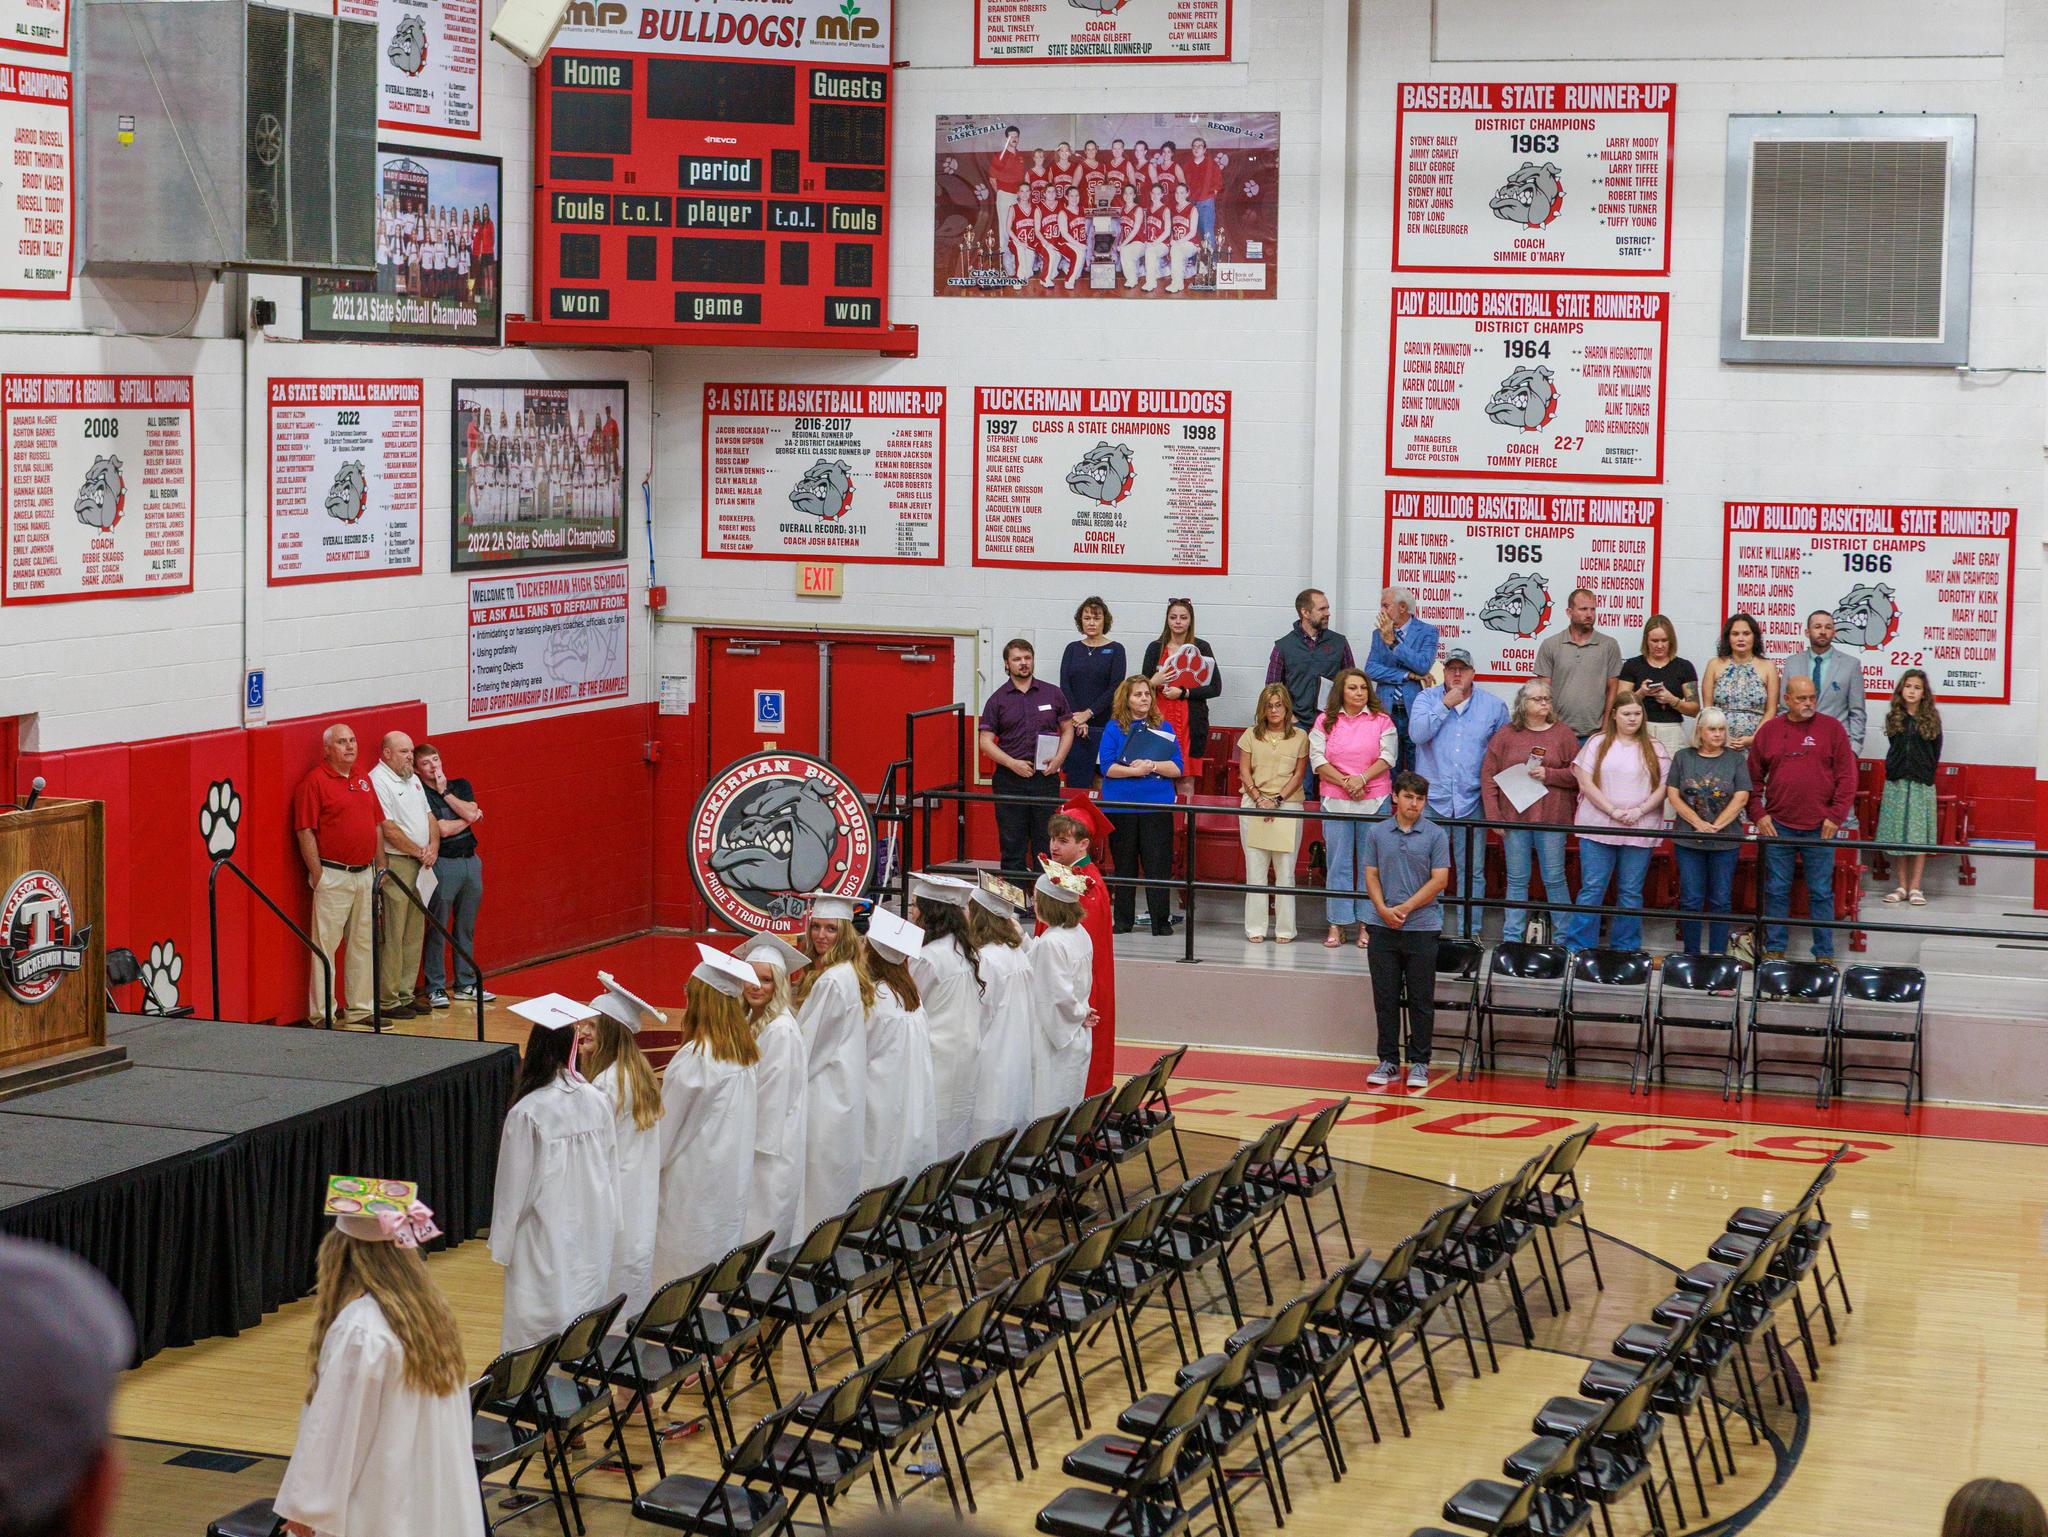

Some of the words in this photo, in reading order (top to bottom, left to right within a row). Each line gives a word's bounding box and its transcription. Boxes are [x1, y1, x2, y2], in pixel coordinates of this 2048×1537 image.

[637, 8, 807, 48] BULLDOGS!
[988, 25, 1005, 33] PAUL
[1007, 25, 1035, 33] TINSLEY
[1085, 21, 1117, 31] COACH
[1048, 44, 1068, 56] STATE
[1070, 43, 1111, 55] BASKETBALL
[1113, 42, 1153, 55] RUNNER-UP
[564, 60, 620, 87] Home
[18, 70, 68, 99] CHAMPIONS
[815, 72, 882, 99] Guests
[1403, 85, 1493, 109] BASEBALL
[1501, 85, 1555, 110] STATE
[1565, 85, 1670, 110] RUNNER-UP
[947, 122, 1007, 143] BASKETBALL
[1207, 121, 1242, 135] RECORD
[1475, 119, 1526, 131] DISTRICT
[1529, 119, 1595, 131] CHAMPIONS
[1410, 136, 1435, 146] SYDNEY
[1436, 136, 1458, 146] BAILEY
[1510, 134, 1559, 153] 1963
[1601, 150, 1633, 160] MILLARD
[1635, 150, 1659, 160] SMITH
[690, 159, 750, 185] period
[558, 196, 605, 220] fouls
[688, 200, 752, 227] player
[776, 208, 816, 228] t.o.l.
[833, 206, 877, 231] fouls
[1514, 239, 1545, 249] COACH
[1493, 251, 1527, 262] SIMMIE
[1530, 251, 1566, 262] O'MARY
[948, 277, 976, 286] STATE
[977, 277, 1028, 287] CHAMPIONS
[562, 294, 600, 313] won
[694, 297, 743, 320] game
[836, 303, 871, 321] won
[1397, 291, 1424, 315] LADY
[1428, 292, 1478, 316] BULLDOG
[1482, 292, 1552, 317] BASKETBALL
[1556, 294, 1590, 318] STATE
[1593, 294, 1660, 320] RUNNER-UP
[332, 296, 356, 320] 2021
[357, 298, 369, 321] 2A
[370, 298, 395, 322] State
[396, 300, 431, 324] Softball
[431, 302, 477, 330] Champions
[1475, 321, 1529, 333] DISTRICT
[1534, 321, 1584, 335] CHAMPS
[1503, 340, 1551, 359] 1964
[1584, 346, 1608, 360] SHARON
[1609, 346, 1653, 361] HIGGINBOTTOM
[43, 379, 74, 403] DISTRICT
[76, 380, 81, 403] &
[83, 379, 116, 404] REGIONAL
[120, 380, 151, 404] SOFTBALL
[154, 380, 190, 404] CHAMPIONS
[273, 384, 286, 401] 2A
[288, 384, 318, 402] STATE
[320, 384, 366, 402] SOFTBALL
[368, 385, 419, 402] CHAMPIONS
[1402, 379, 1425, 392] KAREN
[1427, 379, 1455, 393] COLLOM
[707, 388, 731, 411] 3-A
[733, 389, 774, 412] STATE
[779, 389, 864, 414] BASKETBALL
[869, 391, 943, 414] RUNNER-UP
[981, 388, 1082, 412] TUCKERMAN
[1090, 390, 1132, 412] LADY
[1137, 391, 1226, 414] BULLDOGS
[337, 411, 360, 425] 2022
[795, 418, 851, 431] 2016-2017
[986, 420, 1018, 434] 1997
[84, 418, 119, 438] 2008
[1032, 421, 1065, 434] CLASS
[1068, 422, 1075, 434] A
[1079, 422, 1108, 435] STATE
[1112, 422, 1171, 436] CHAMPIONS
[1183, 425, 1217, 440] 1998
[1506, 444, 1539, 455] COACH
[1554, 436, 1584, 452] 22-7
[1487, 456, 1522, 468] TOMMY
[1525, 457, 1557, 469] PIERCE
[1392, 493, 1420, 517] LADY
[1423, 494, 1473, 518] BULLDOG
[1477, 495, 1546, 521] BASKETBALL
[1551, 498, 1585, 521] STATE
[1588, 499, 1655, 524] RUNNER-UP
[780, 524, 816, 534] OVERALL
[817, 524, 847, 535] RECORD:
[848, 525, 867, 535] 31-11
[1730, 505, 1760, 530] LADY
[1764, 506, 1816, 531] BULLDOG
[1820, 507, 1894, 533] BASKETBALL
[1900, 509, 1936, 534] STATE
[1940, 510, 2010, 536] RUNNER-UP
[468, 531, 490, 552] 2022
[492, 532, 505, 551] 2A
[506, 531, 530, 550] State
[532, 528, 566, 548] Softball
[567, 526, 616, 549] Champions
[1085, 532, 1116, 542] COACH
[1466, 525, 1520, 538] DISTRICT
[1524, 526, 1575, 539] CHAMPS
[91, 538, 115, 549] COACH
[1073, 543, 1099, 554] ALVIN
[1100, 543, 1126, 555] RILEY
[1811, 538, 1868, 551] DISTRICT
[1873, 539, 1925, 552] CHAMPS
[1496, 544, 1543, 563] 1965
[1739, 546, 1763, 560] VICKIE
[1765, 547, 1800, 561] WILLIAMS
[1842, 553, 1892, 573] 1966
[472, 588, 504, 603] WELCOME
[506, 588, 515, 599] TO
[516, 579, 570, 598] TUCKERMAN
[571, 576, 590, 592] HIGH
[591, 572, 625, 590] SCHOOL
[804, 567, 833, 591] EXIT
[472, 611, 487, 623] WE
[489, 609, 507, 622] ASK
[509, 607, 524, 620] ALL
[526, 605, 549, 619] FANS
[551, 603, 562, 615] TO
[564, 599, 599, 614] REFRAIN
[600, 597, 626, 610] FROM:
[1952, 609, 1974, 623] MARY
[1978, 609, 1997, 623] HOLT
[477, 648, 492, 657] Using
[494, 644, 518, 658] profanity
[1890, 652, 1923, 667] 22-2
[477, 663, 502, 674] Throwing
[503, 660, 524, 672] Objects
[698, 760, 790, 853] TUCKERMAN
[840, 874, 860, 897] 903
[706, 872, 730, 904] PRIDE
[726, 900, 736, 911] &
[735, 907, 792, 931] TRADITION
[20, 898, 62, 952] T
